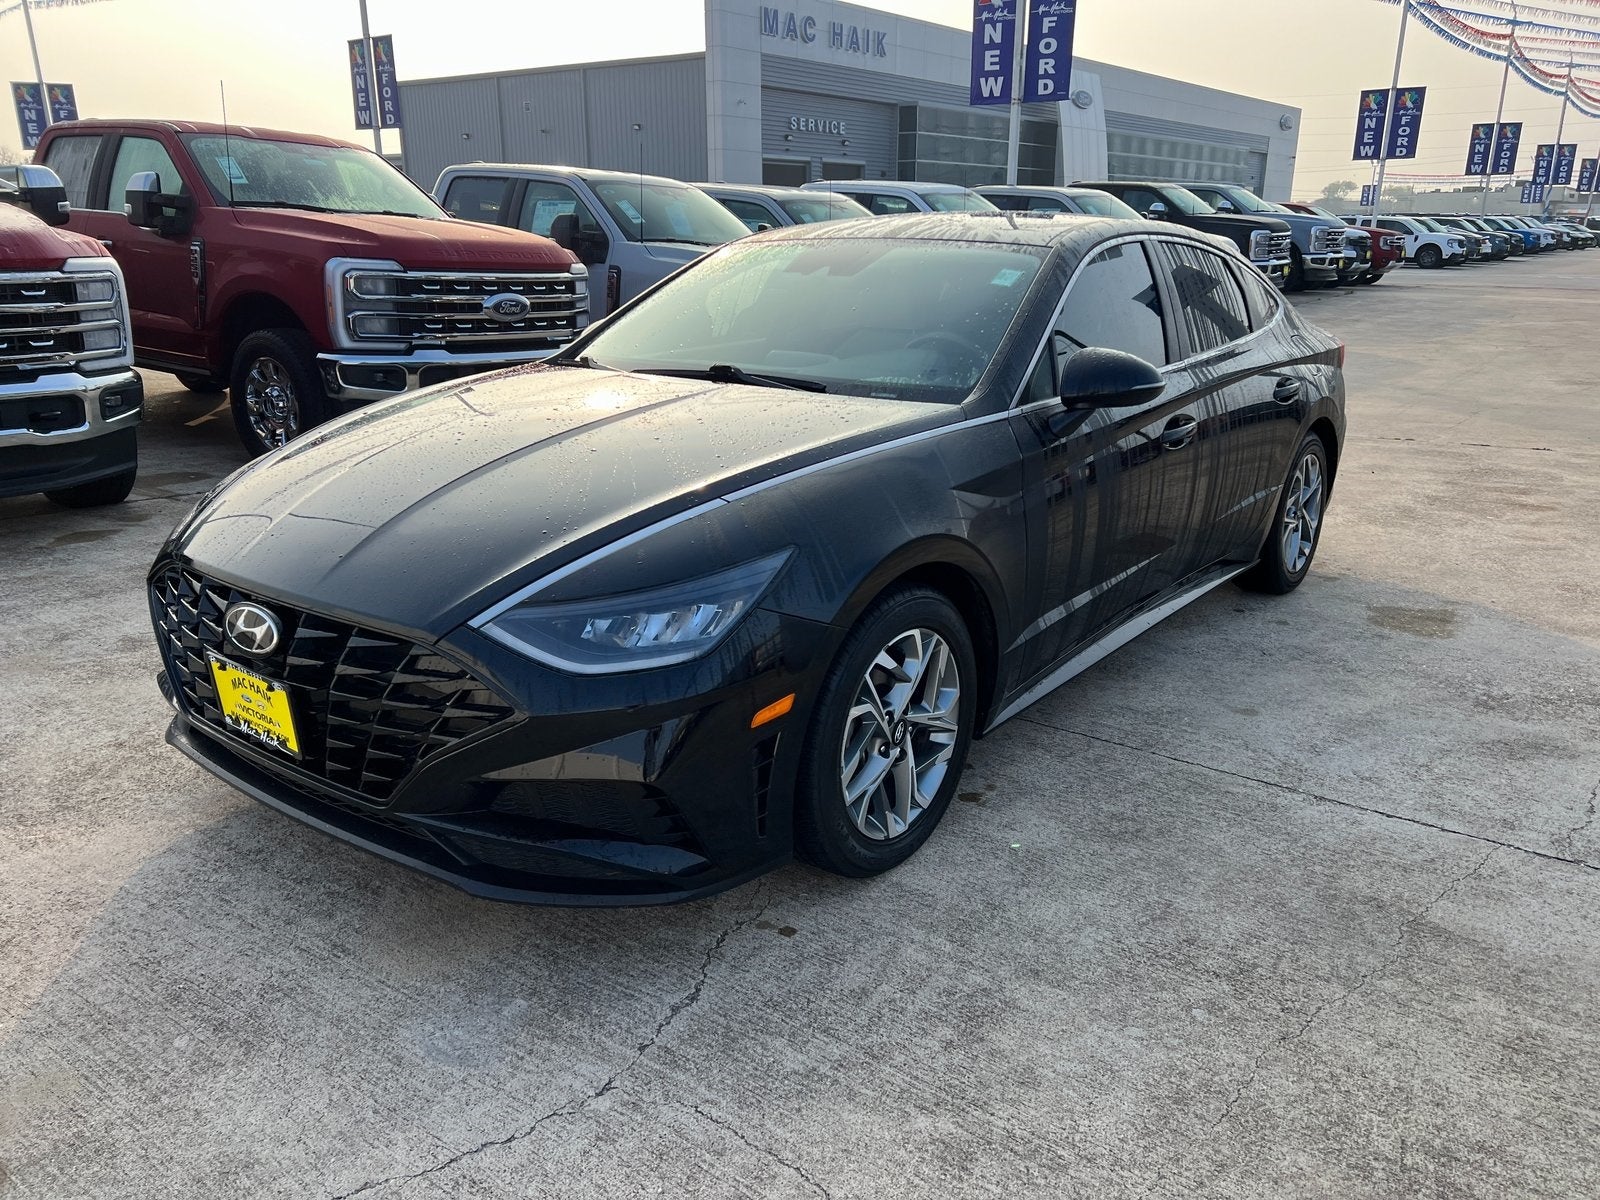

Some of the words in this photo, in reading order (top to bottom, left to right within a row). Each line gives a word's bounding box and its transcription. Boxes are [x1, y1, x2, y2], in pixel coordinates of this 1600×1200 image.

[761, 6, 816, 43] MAC
[830, 22, 887, 57] HAIK
[979, 22, 1004, 98] NEW
[1037, 16, 1058, 95] FORD
[355, 74, 370, 125] NEW
[381, 73, 395, 125] FORD
[790, 116, 846, 134] SERVICE
[1360, 117, 1377, 157] NEW
[1395, 116, 1411, 156] FORD
[1470, 143, 1485, 174] NEW
[1498, 143, 1512, 173] FORD
[1536, 160, 1548, 184] NEW
[1580, 172, 1590, 191] NEW
[499, 300, 522, 314] Ford
[231, 676, 249, 690] MAC
